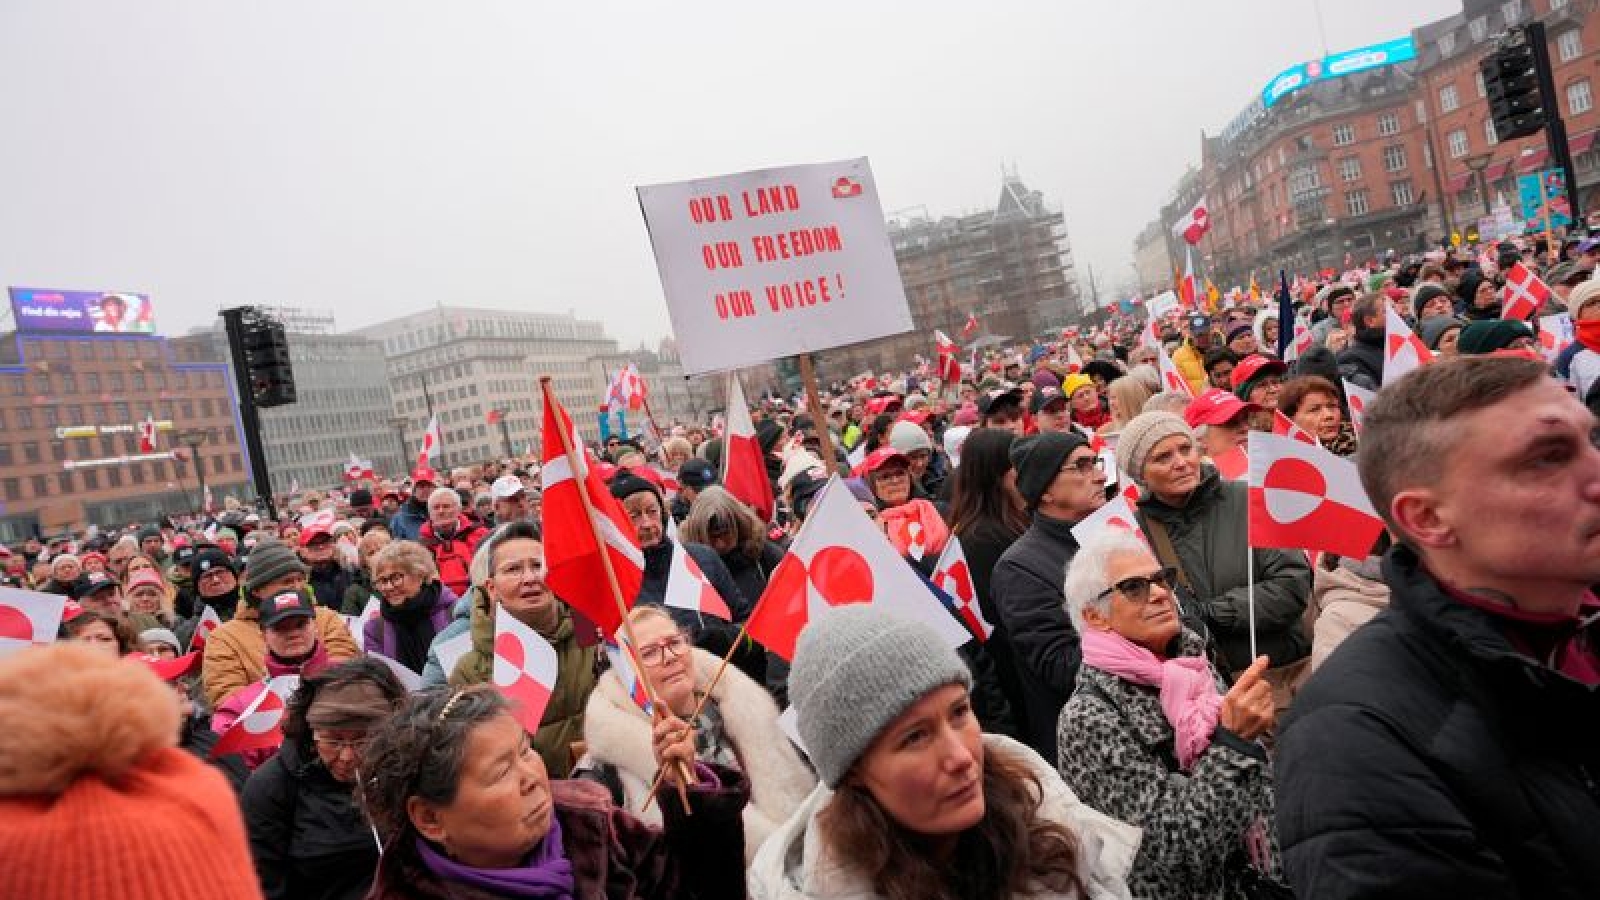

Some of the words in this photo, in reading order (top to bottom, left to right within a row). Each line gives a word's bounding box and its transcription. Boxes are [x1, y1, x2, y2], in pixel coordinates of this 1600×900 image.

[688, 194, 733, 225] OUR
[742, 184, 800, 217] LAND
[702, 241, 743, 270] OUR
[752, 225, 842, 262] FREEDOM
[715, 289, 756, 320] OUR
